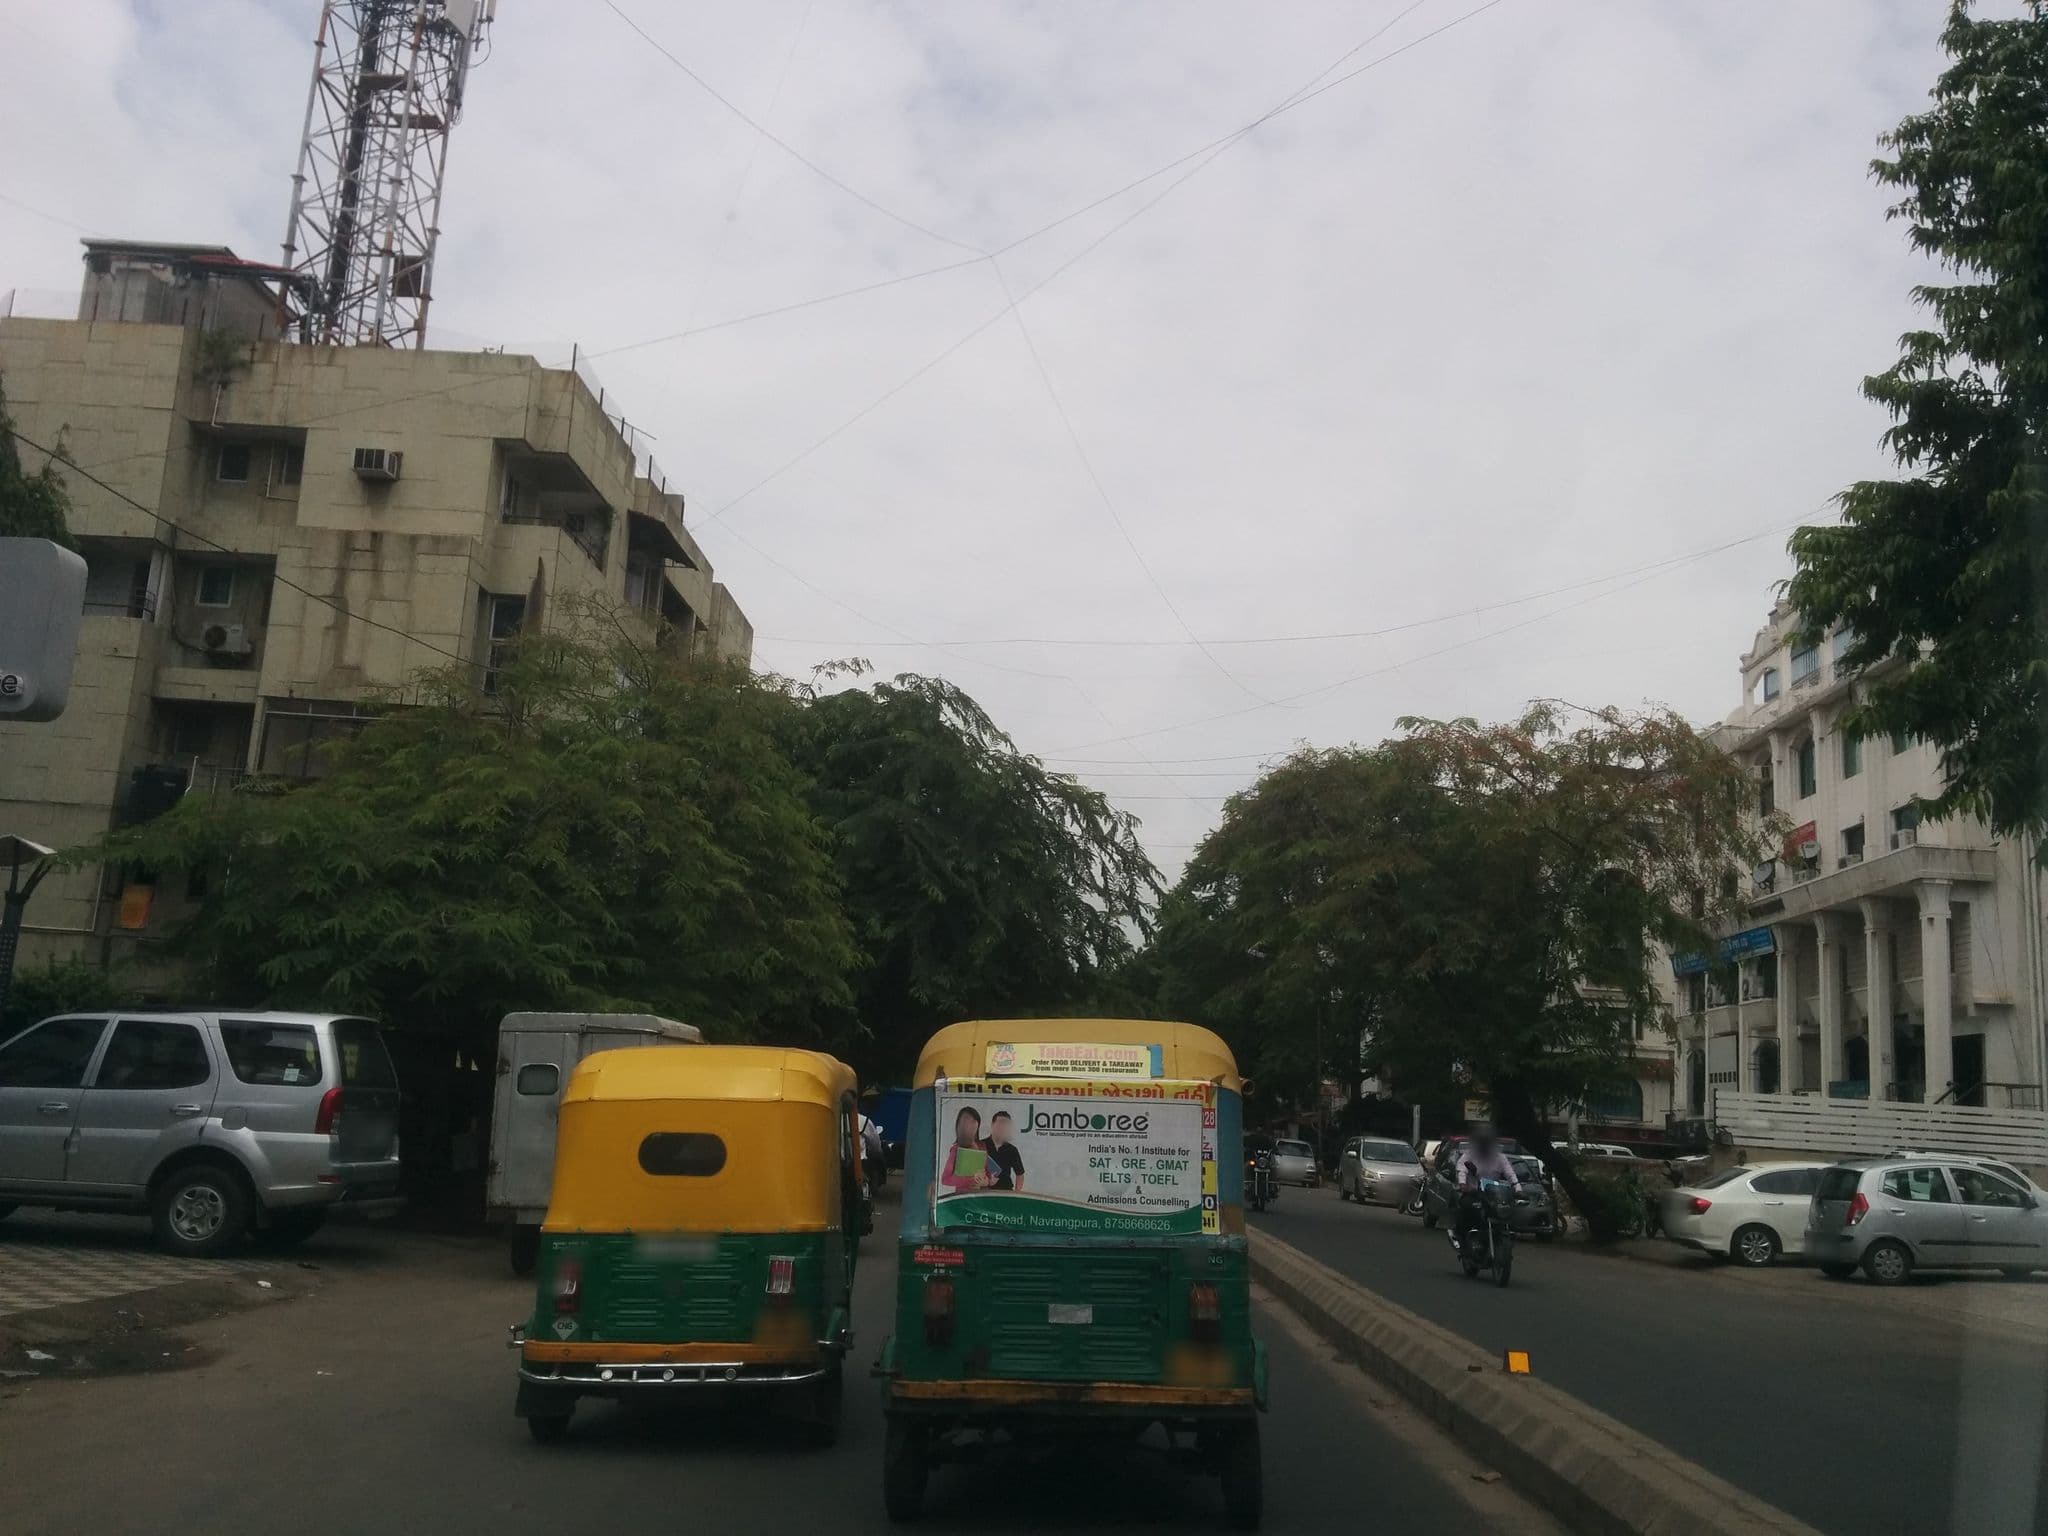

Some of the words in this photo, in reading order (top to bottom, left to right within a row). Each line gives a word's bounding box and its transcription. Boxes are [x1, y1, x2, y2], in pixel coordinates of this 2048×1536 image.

[1020, 1103, 1149, 1133] Jamboree
[1088, 1144, 1116, 1154] India's
[1118, 1145, 1132, 1154] No.
[1135, 1146, 1139, 1154] 1
[1142, 1146, 1176, 1156] Institute
[1178, 1147, 1190, 1156] for
[1089, 1157, 1112, 1168] SAT
[1121, 1158, 1146, 1169] GRE
[1156, 1159, 1189, 1171] GMAT
[1099, 1172, 1131, 1184] IELTS
[1141, 1173, 1179, 1185] TOEFL
[1135, 1185, 1142, 1194] &
[1087, 1194, 1137, 1205] Admissions
[1139, 1195, 1190, 1209] Counselling
[995, 1213, 1026, 1227] Road,
[1030, 1215, 1101, 1230] Navrangpura,
